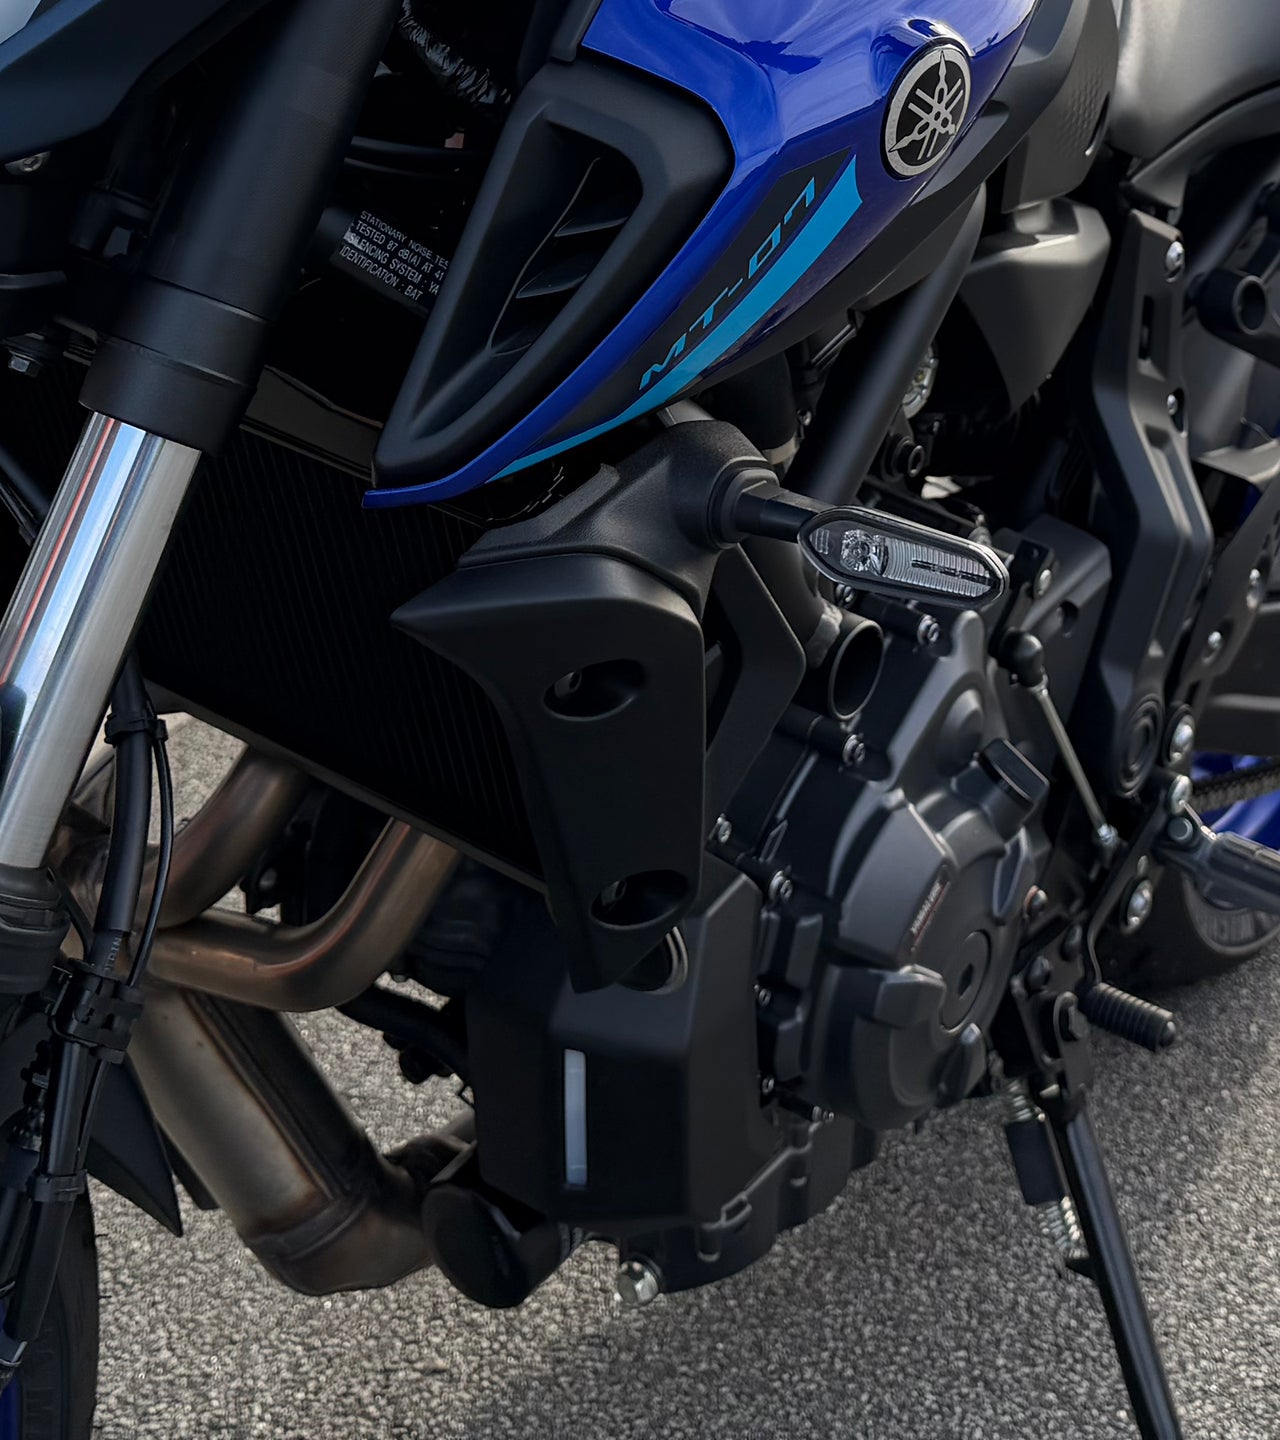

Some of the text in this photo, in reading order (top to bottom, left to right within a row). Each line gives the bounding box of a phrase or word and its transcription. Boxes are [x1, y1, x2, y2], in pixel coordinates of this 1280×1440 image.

[348, 232, 390, 265] SILENCING
[389, 258, 423, 284] SYSTEM
[355, 220, 386, 244] TESTED
[386, 242, 399, 252] 87
[398, 247, 422, 267] dB(A)
[421, 261, 434, 274] AT
[360, 210, 408, 243] STATIONARY
[408, 239, 432, 260] NOISE
[339, 244, 400, 288] IDENTIFICATION
[404, 285, 424, 302] BAT
